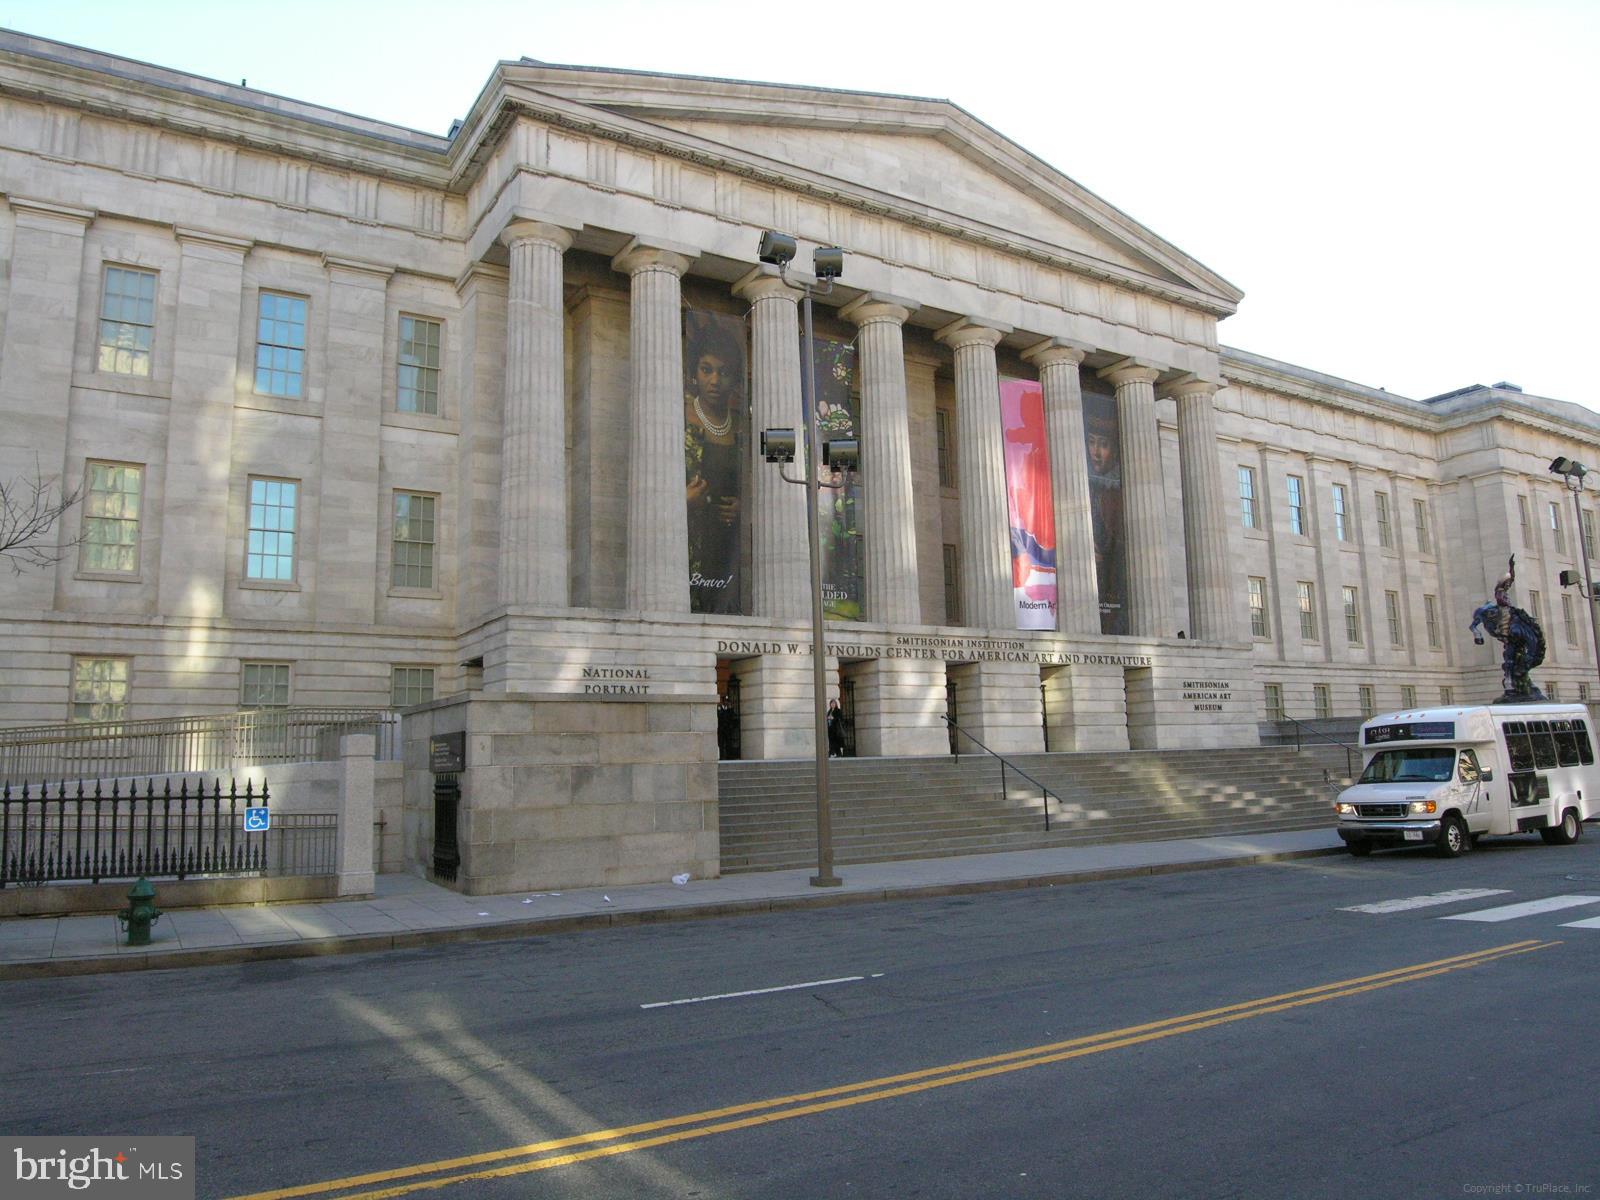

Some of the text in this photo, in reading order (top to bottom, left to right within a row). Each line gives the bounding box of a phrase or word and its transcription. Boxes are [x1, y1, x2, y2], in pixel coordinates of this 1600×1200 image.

[689, 572, 733, 589] Bravo!
[1019, 600, 1047, 609] Modern
[896, 637, 1025, 650] SMITHSONIAN INSTITUTION
[718, 641, 782, 655] DONALD
[787, 643, 802, 655] W.
[886, 647, 937, 660] CENTER
[942, 649, 965, 661] FOR
[969, 650, 1030, 663] AMERICAN
[1033, 652, 1055, 663] ART
[1058, 653, 1080, 664] AND
[1084, 655, 1153, 666] PORTRAITURE
[582, 668, 650, 679] NATIONAL
[585, 684, 650, 695] PORTRAIT
[1183, 681, 1230, 689] SMITHSONIAN
[1183, 692, 1218, 700] AMERICAN
